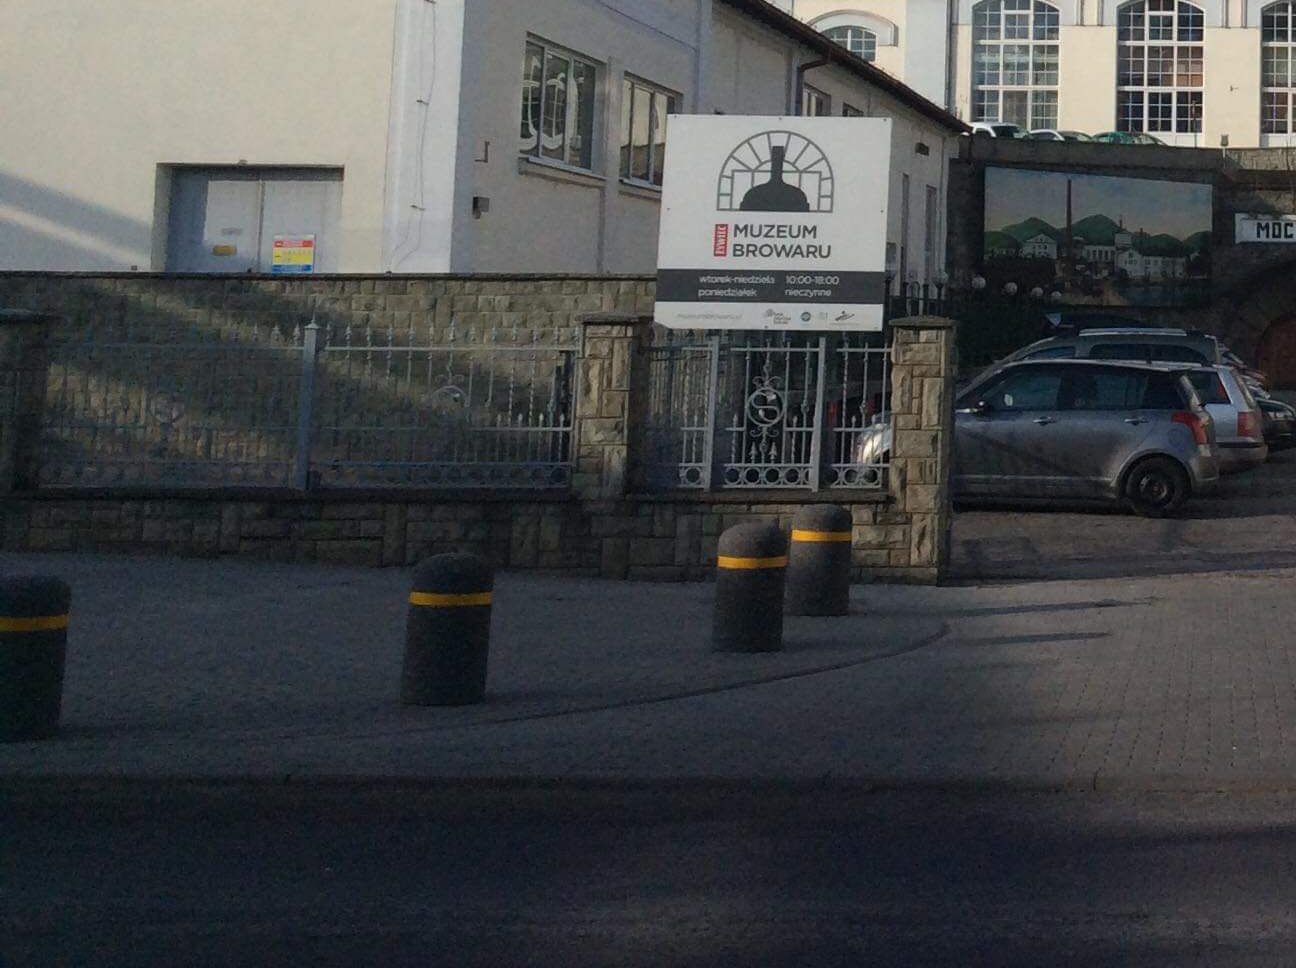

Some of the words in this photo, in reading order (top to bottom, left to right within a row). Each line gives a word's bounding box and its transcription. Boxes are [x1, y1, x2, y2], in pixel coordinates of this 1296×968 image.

[733, 224, 817, 238] MUZEUM
[732, 243, 832, 259] BROWARU
[785, 288, 832, 298] nieczynne
